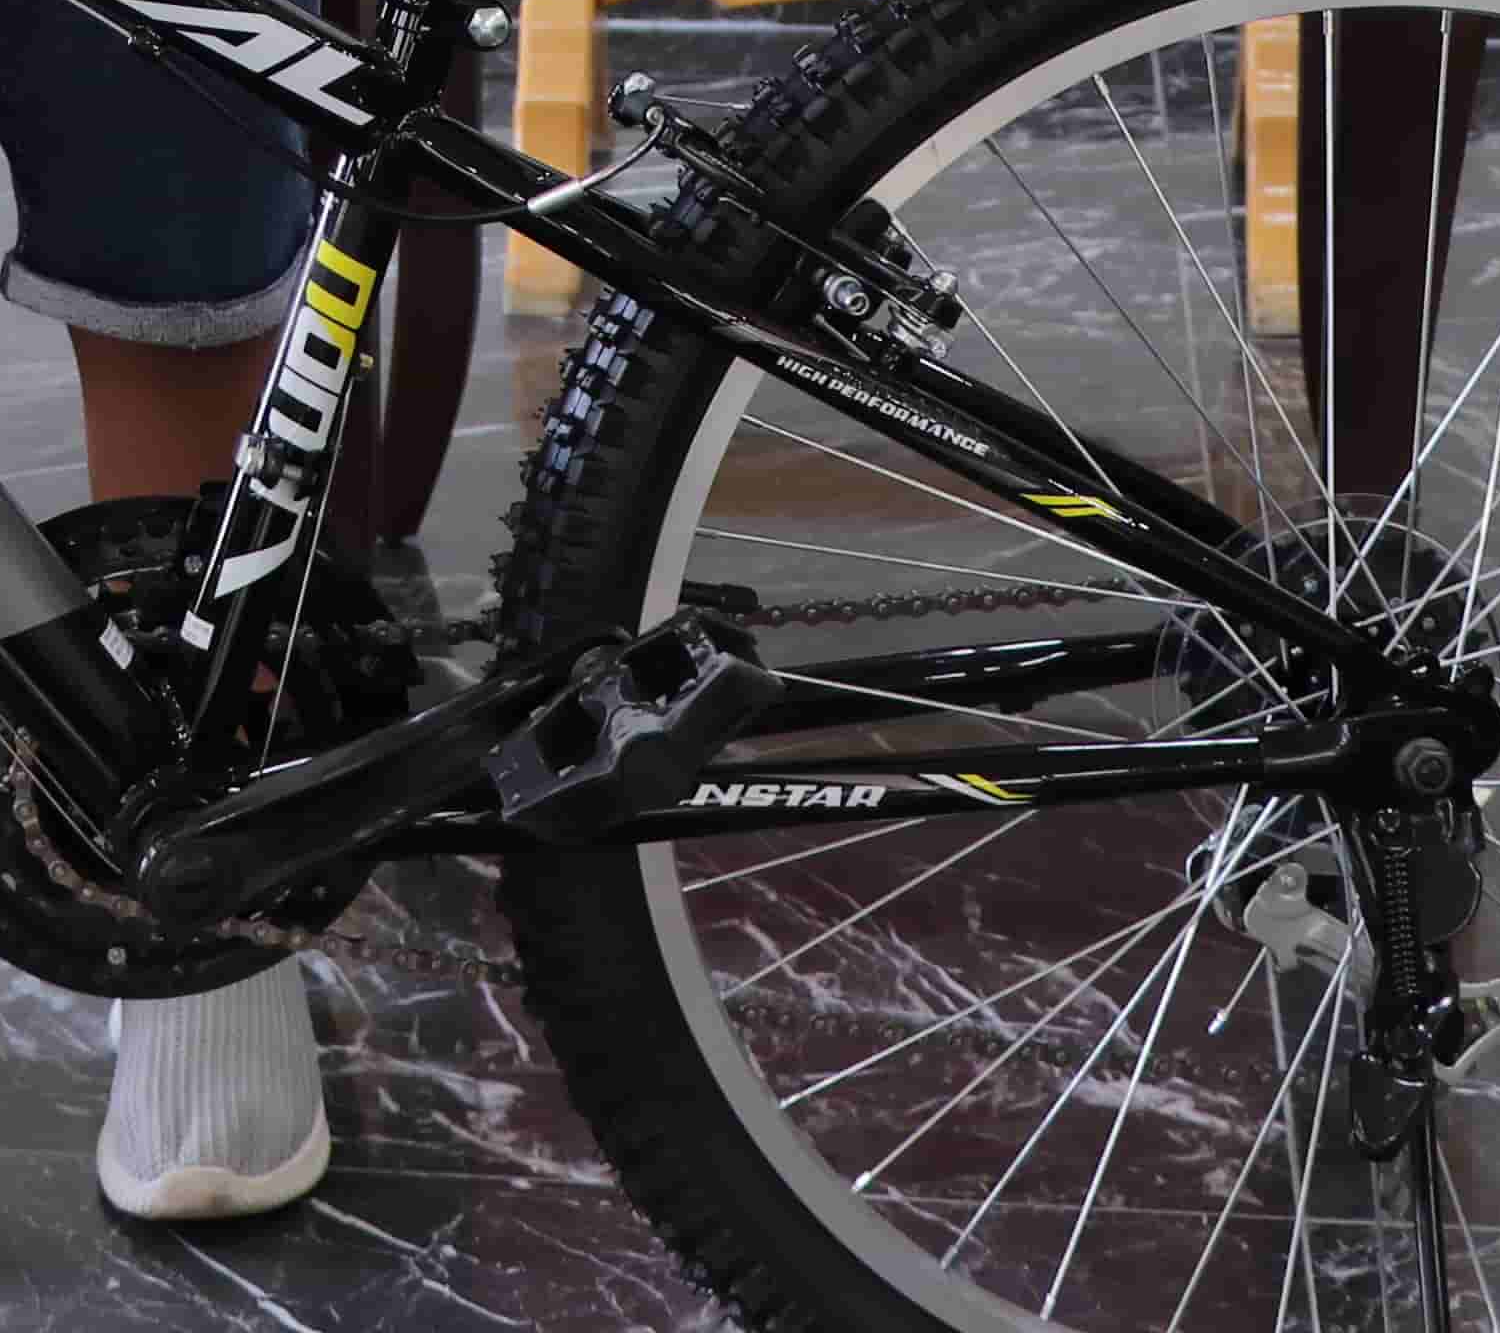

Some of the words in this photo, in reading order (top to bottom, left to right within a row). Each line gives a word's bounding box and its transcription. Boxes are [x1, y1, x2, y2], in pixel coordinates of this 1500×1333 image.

[776, 354, 830, 386] HIGH
[826, 378, 991, 457] PERFORMANCE
[679, 783, 888, 808] NSTAR
